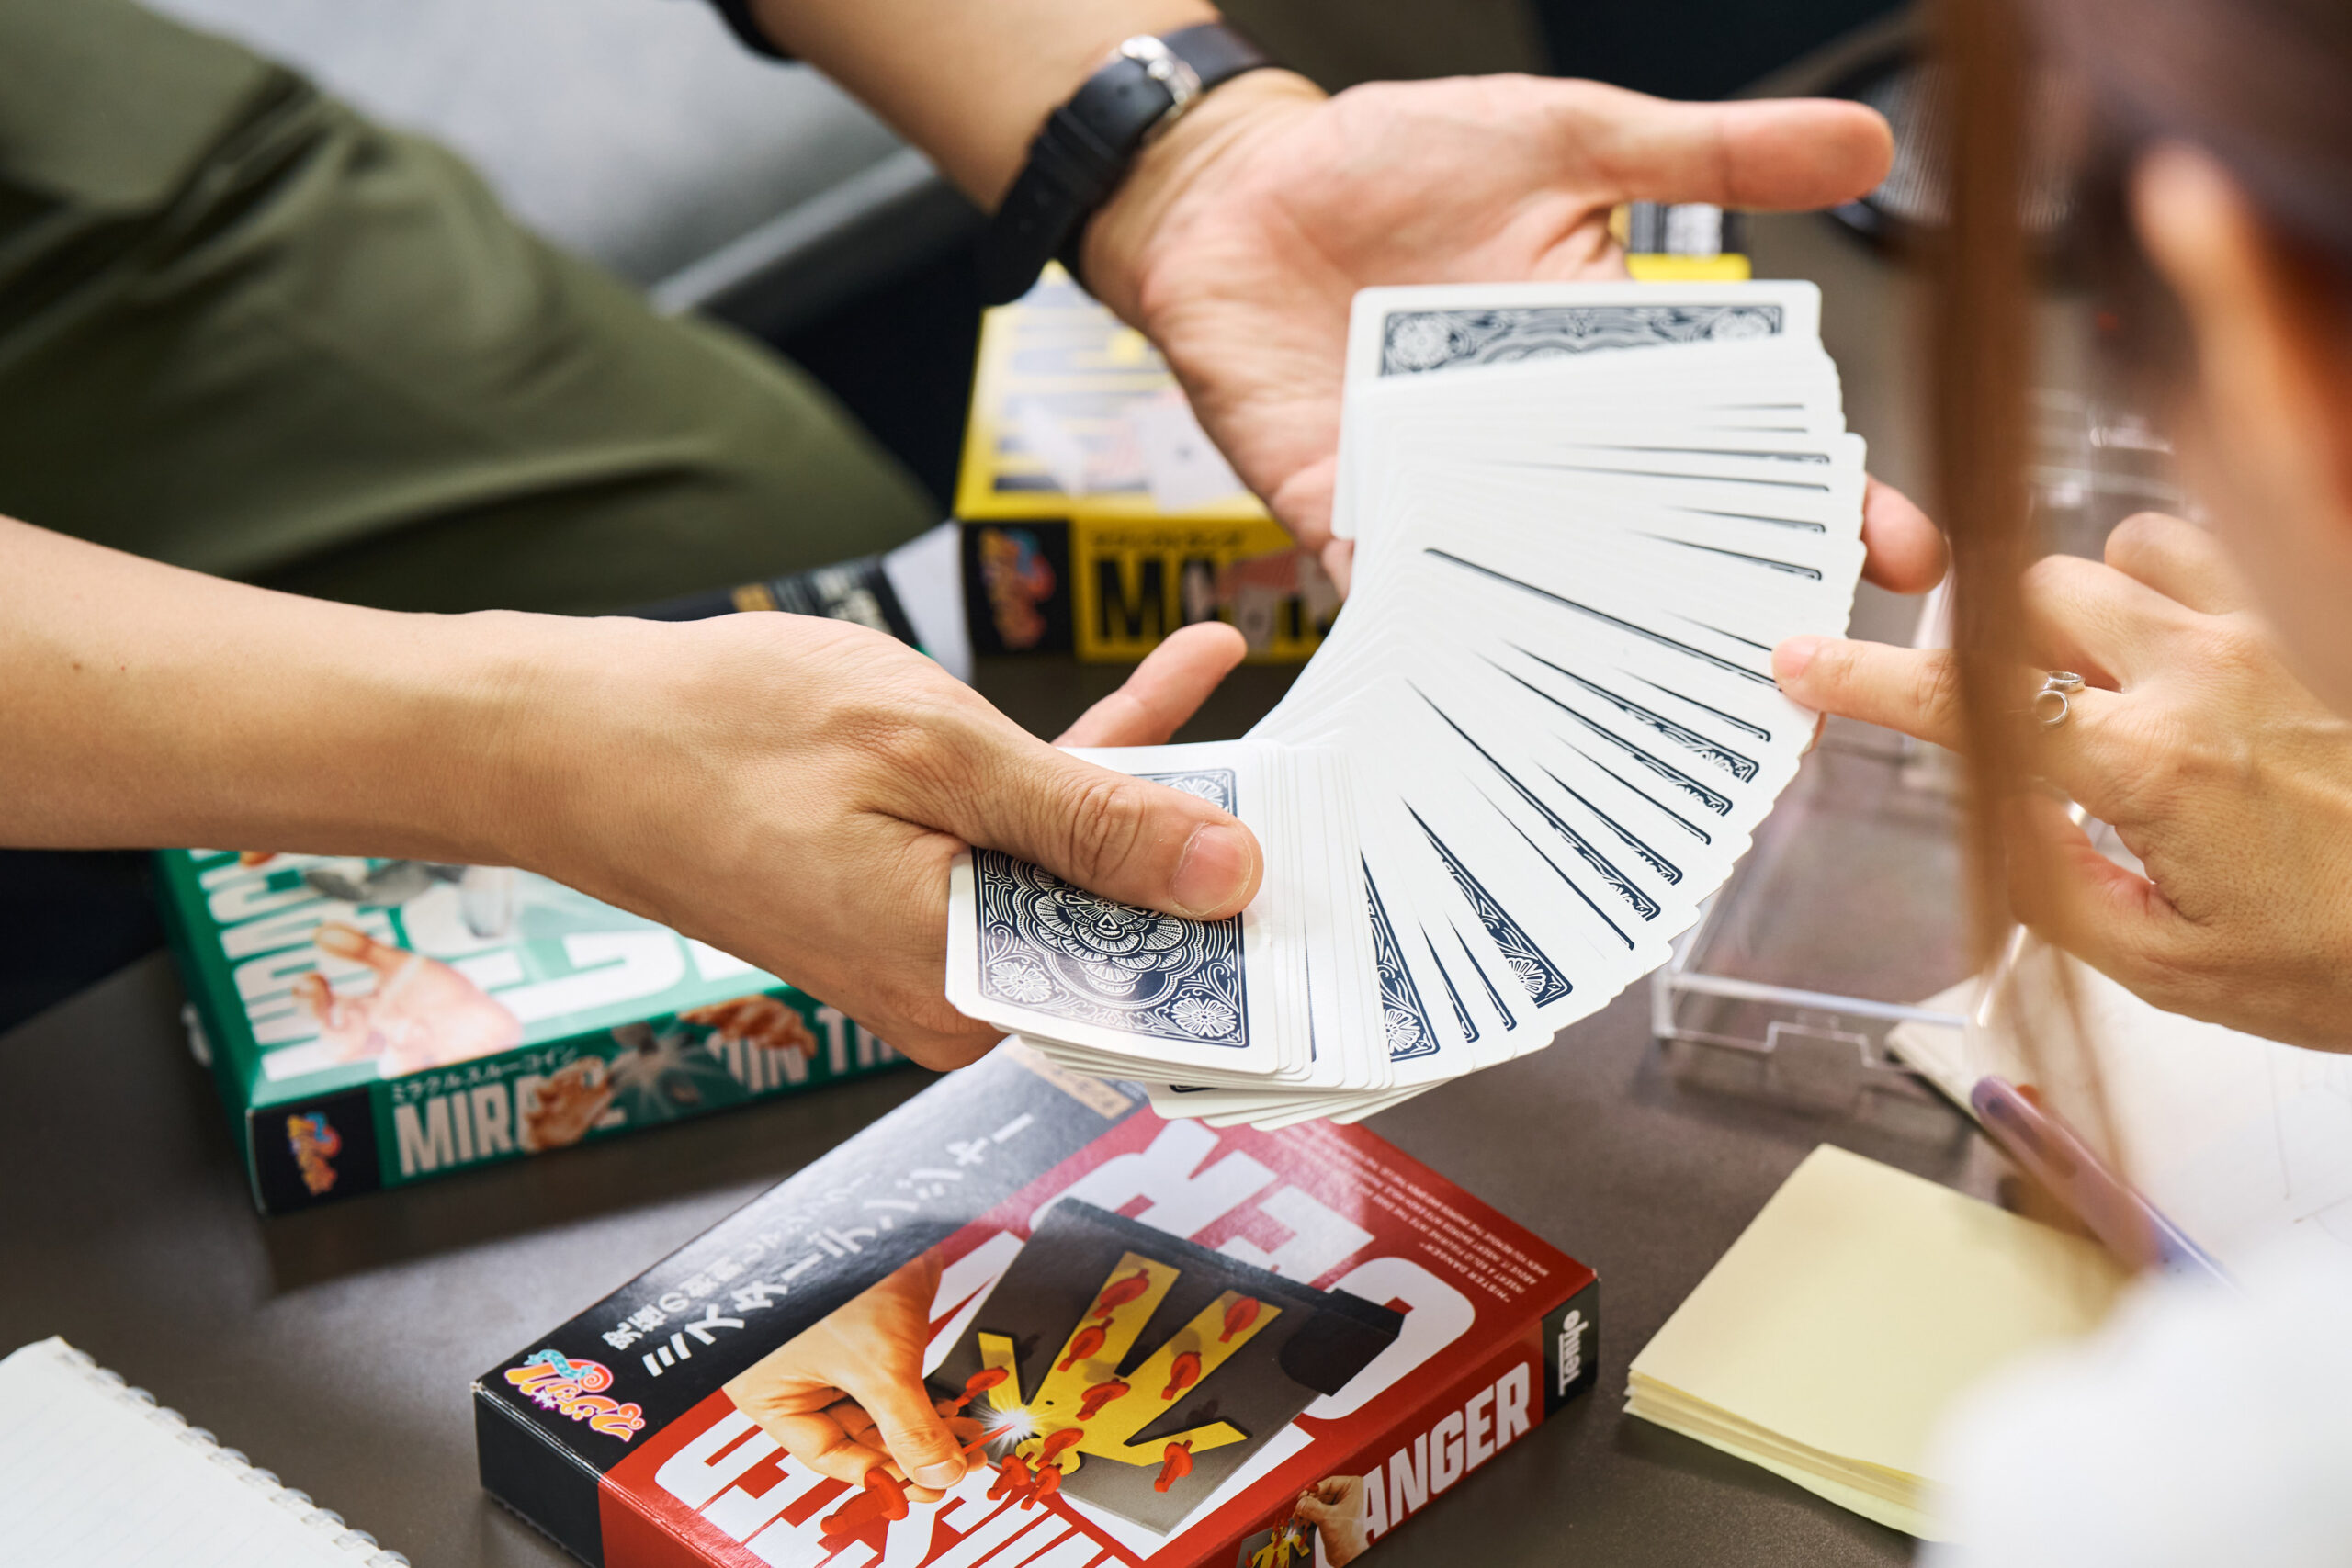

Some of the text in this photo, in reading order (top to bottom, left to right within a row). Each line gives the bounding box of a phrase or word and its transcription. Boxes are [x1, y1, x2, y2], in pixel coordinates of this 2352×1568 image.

[643, 1112, 1035, 1378] ミスターデンジャー
[1557, 1309, 1581, 1397] Tenyo
